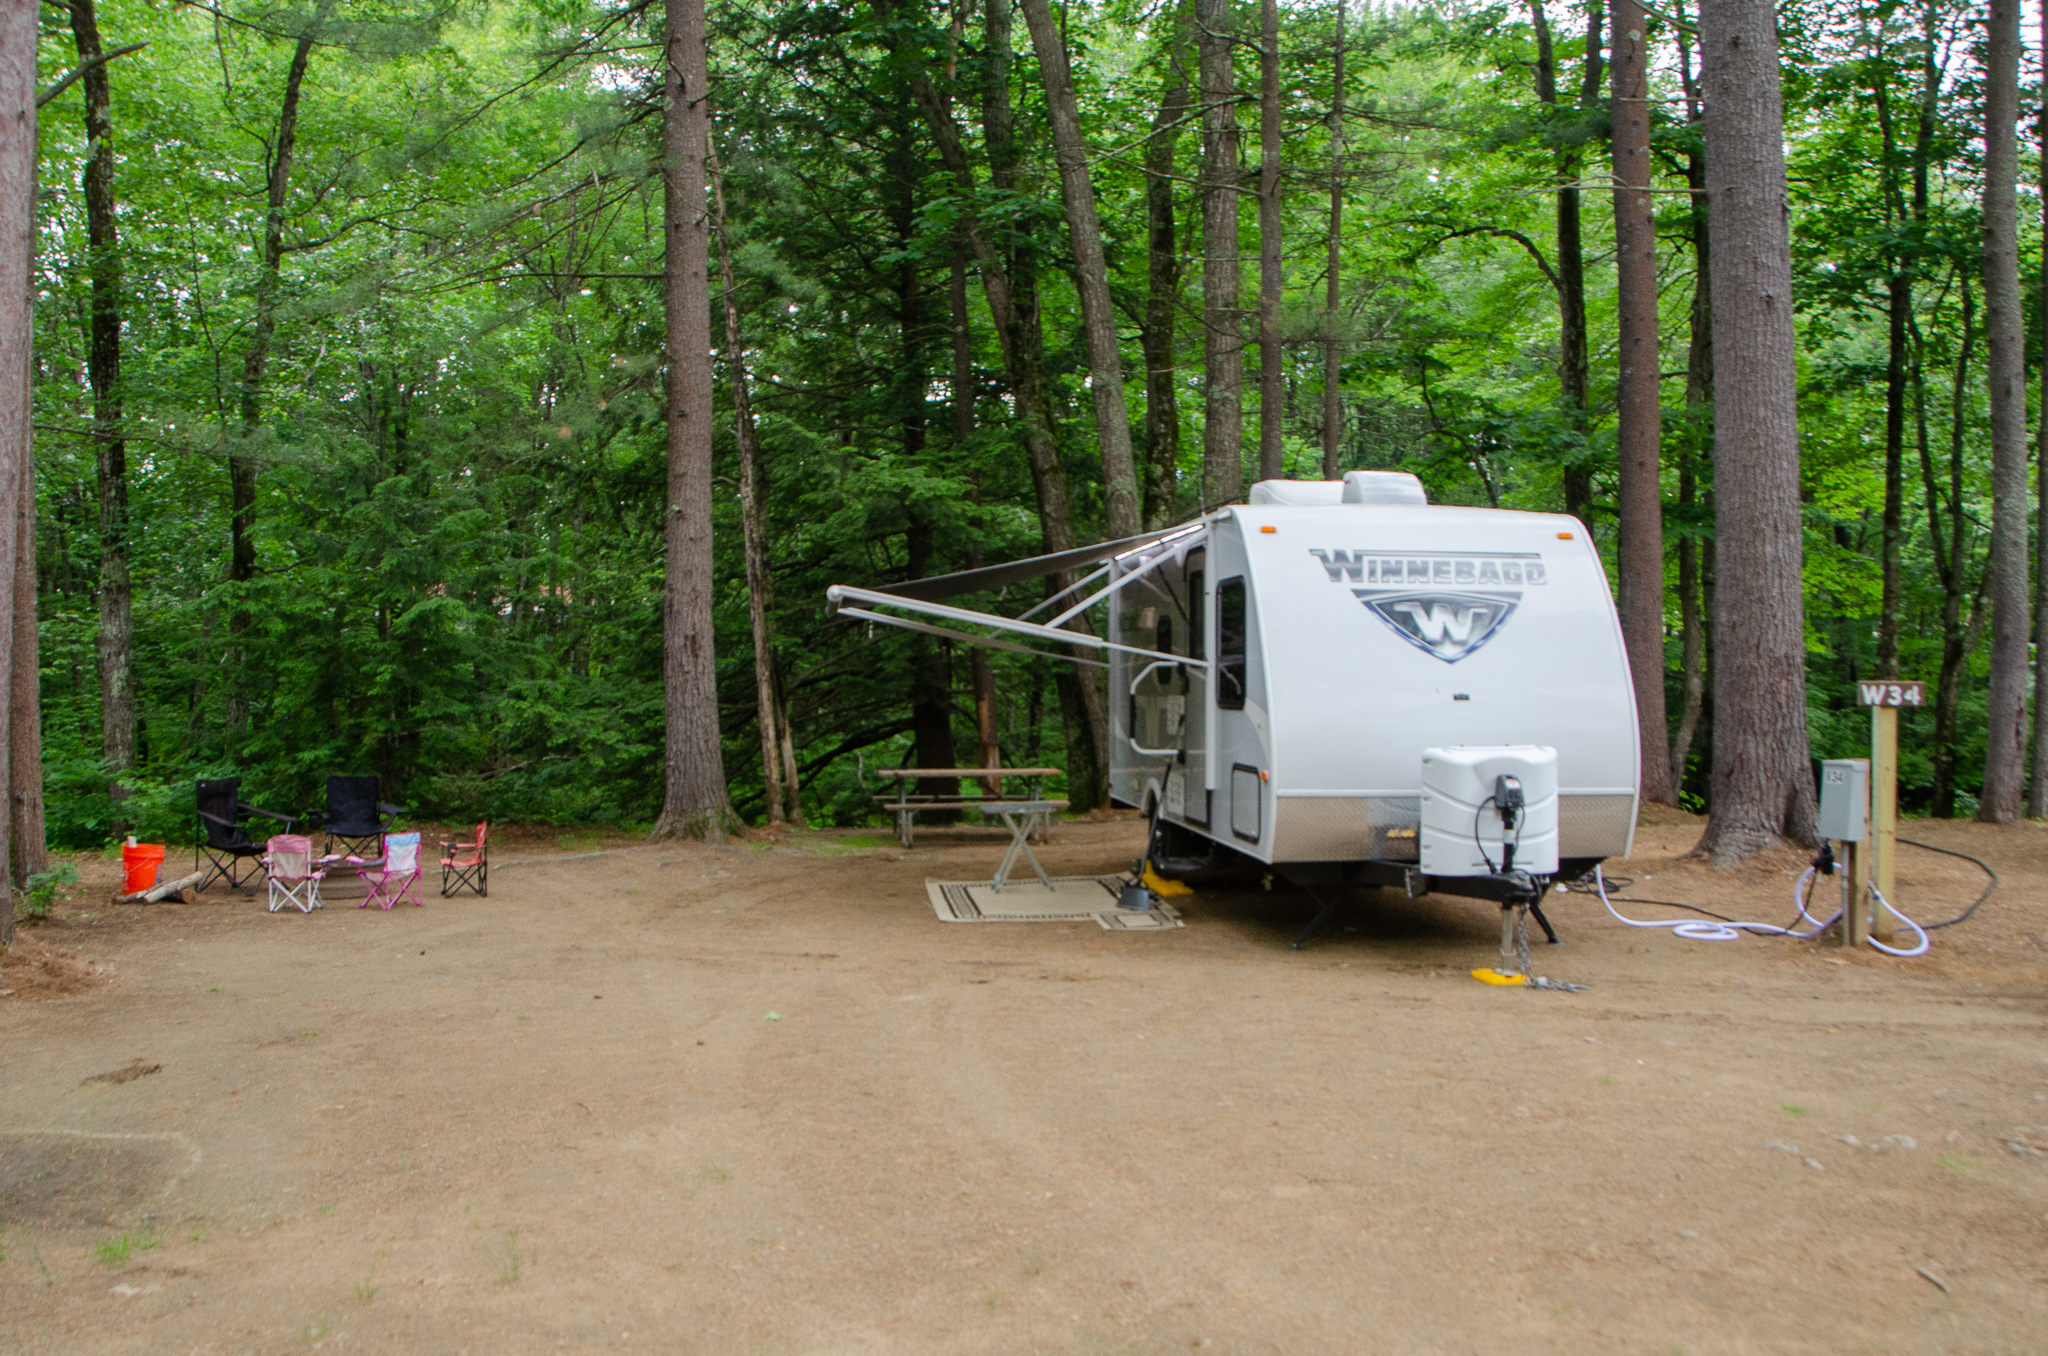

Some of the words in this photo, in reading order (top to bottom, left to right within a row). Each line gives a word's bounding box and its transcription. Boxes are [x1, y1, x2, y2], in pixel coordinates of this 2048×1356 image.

[1308, 549, 1547, 585] WINNEBAGO
[1394, 602, 1488, 643] W
[1861, 685, 1922, 706] W34
